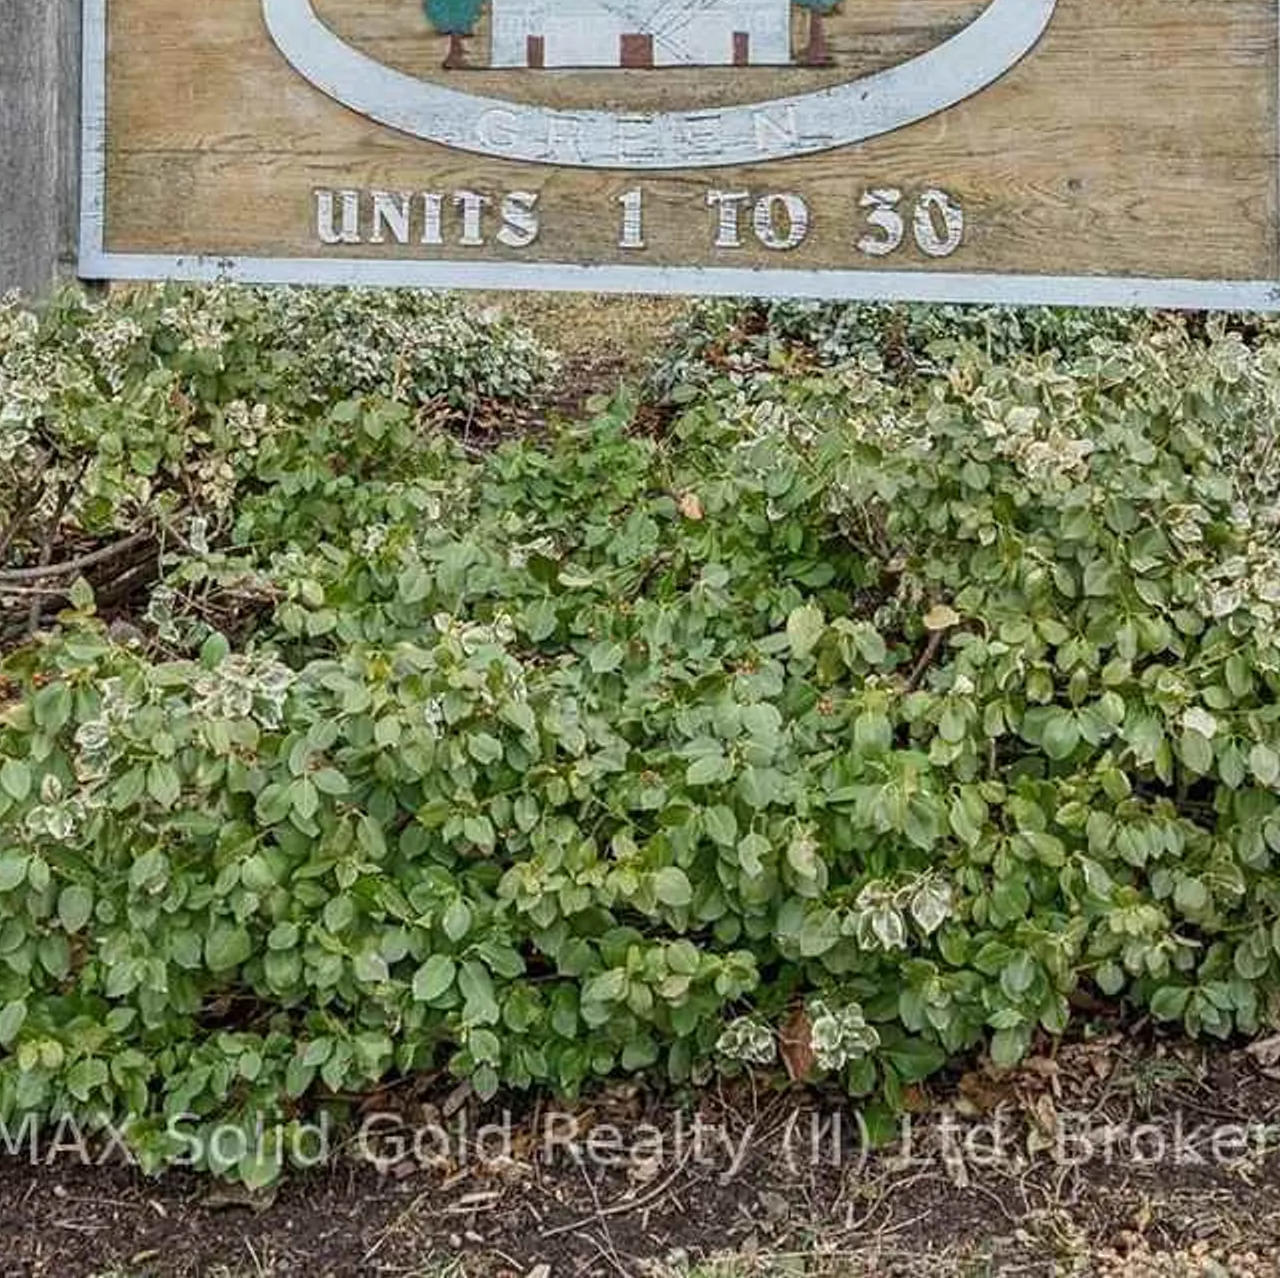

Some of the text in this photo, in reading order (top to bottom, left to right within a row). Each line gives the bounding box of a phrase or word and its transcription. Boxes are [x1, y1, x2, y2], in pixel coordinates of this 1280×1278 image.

[477, 103, 802, 163] GREEN
[313, 185, 966, 259] UNITS 1 TO 30
